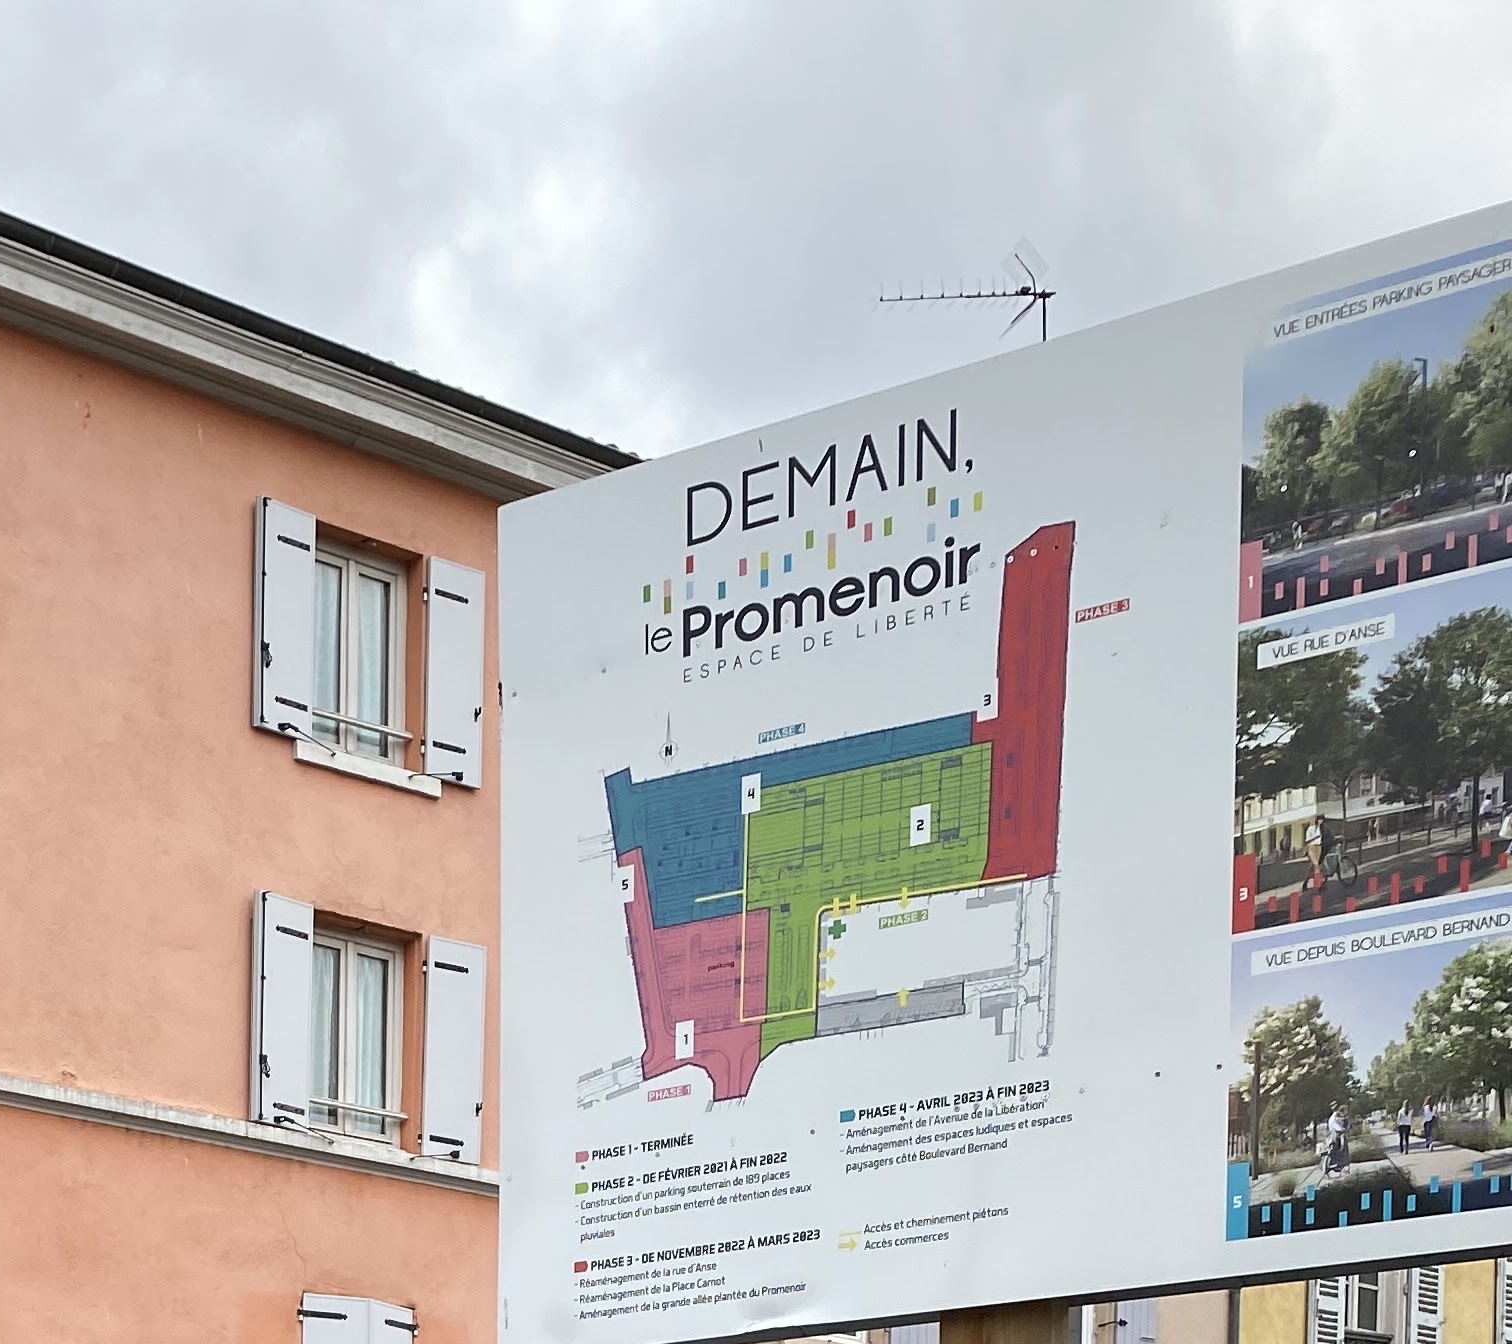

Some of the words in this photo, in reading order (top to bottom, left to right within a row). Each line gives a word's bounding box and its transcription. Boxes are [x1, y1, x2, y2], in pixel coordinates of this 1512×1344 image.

[1273, 319, 1300, 338] VUE
[1305, 299, 1368, 330] ENTRÉES
[1372, 281, 1433, 310] PARKING
[686, 408, 975, 547] DEMAIN,
[644, 622, 673, 656] le
[683, 536, 981, 658] Promenoir
[1076, 601, 1118, 622] PHASE
[1121, 599, 1129, 611] 3
[683, 644, 781, 684] ESPACE
[803, 634, 834, 654] DE
[856, 592, 972, 640] LIBERTÉ
[1272, 638, 1299, 659] VUE
[1304, 633, 1330, 654] RUE
[1334, 620, 1386, 648] D'ANSE
[983, 694, 991, 707] 3
[759, 726, 795, 743] PHASE
[797, 723, 805, 734] 4
[747, 788, 756, 800] 4
[915, 818, 925, 832] 2
[621, 879, 629, 890] 5
[1239, 888, 1248, 901] 3
[880, 912, 916, 927] PHASE
[919, 910, 928, 921] 2
[1266, 951, 1292, 967] VUE
[1297, 941, 1345, 962] DEPUIS
[1351, 926, 1437, 953] BOULEVARD
[1443, 913, 1510, 937] BERNAND
[648, 1088, 684, 1102] PHASE
[858, 1104, 896, 1120] PHASE
[900, 1102, 907, 1114] 4
[917, 1096, 950, 1111] AVRIL
[953, 1091, 983, 1106] 2023
[986, 1086, 995, 1100] À
[997, 1084, 1016, 1098] FIN
[1019, 1080, 1049, 1095] 2023
[846, 1121, 913, 1139] Aménagement
[916, 1116, 927, 1127] de
[929, 1112, 968, 1126] l'Avenue
[971, 1108, 982, 1119] de
[984, 1106, 993, 1117] la
[995, 1100, 1044, 1116] Libération
[846, 1137, 912, 1155] Aménagement
[915, 1133, 932, 1145] des
[934, 1125, 973, 1143] espaces
[976, 1122, 1015, 1138] ludiques
[1018, 1119, 1028, 1130] et
[1031, 1113, 1072, 1128] espaces
[592, 1145, 626, 1161] PHASE
[628, 1144, 632, 1155] 1
[641, 1133, 694, 1153] TERMINÉE
[846, 1154, 893, 1174] paysagers
[896, 1149, 917, 1164] côté
[919, 1142, 965, 1160] Boulevard
[968, 1139, 1008, 1153] Bernand
[592, 1176, 625, 1192] PHASE
[628, 1176, 634, 1186] 2
[643, 1172, 656, 1184] DE
[658, 1164, 700, 1182] FÉVRIER
[703, 1161, 727, 1175] 2021
[730, 1157, 738, 1171] À
[740, 1156, 757, 1169] FIN
[759, 1152, 787, 1165] 2022
[581, 1194, 633, 1210] Construction
[635, 1189, 652, 1201] d'un
[654, 1185, 685, 1200] parking
[687, 1179, 731, 1194] souterrain
[733, 1177, 743, 1187] de
[745, 1174, 760, 1185] 189
[761, 1170, 790, 1184] places
[581, 1209, 633, 1225] Construction
[635, 1206, 652, 1217] d'un
[654, 1201, 681, 1214] bassin
[683, 1197, 715, 1210] enterré
[717, 1195, 727, 1205] de
[729, 1188, 770, 1202] rétention
[772, 1186, 787, 1197] des
[789, 1184, 811, 1194] eaux
[1232, 1195, 1242, 1209] 5
[864, 1221, 891, 1234] Accès
[894, 1219, 904, 1229] et
[906, 1211, 970, 1228] cheminement
[972, 1207, 1008, 1222] piétons
[581, 1228, 615, 1244] pluviales
[591, 1256, 624, 1271] PHASE
[627, 1255, 632, 1266] 3
[642, 1252, 654, 1263] DE
[657, 1244, 715, 1262] NOVEMBRE
[718, 1239, 745, 1253] 2022
[747, 1236, 755, 1249] À
[758, 1233, 790, 1247] MARS
[792, 1229, 820, 1242] 2023
[864, 1237, 892, 1250] Accès
[895, 1231, 949, 1246] commerces
[580, 1270, 649, 1289] Réaménagement
[651, 1268, 661, 1278] de
[663, 1267, 670, 1276] la
[672, 1267, 686, 1275] rue
[688, 1262, 717, 1274] d'Anse
[580, 1286, 649, 1304] Réaménagement
[651, 1284, 661, 1294] de
[663, 1283, 670, 1292] la
[672, 1280, 695, 1291] Place
[696, 1275, 725, 1289] Carnot
[579, 1304, 638, 1319] Aménagement
[641, 1300, 650, 1311] de
[652, 1300, 659, 1309] la
[661, 1296, 690, 1310] grande
[692, 1294, 712, 1305] allée
[714, 1289, 747, 1304] plantée
[749, 1287, 760, 1297] du
[762, 1281, 806, 1296] Promenoir
